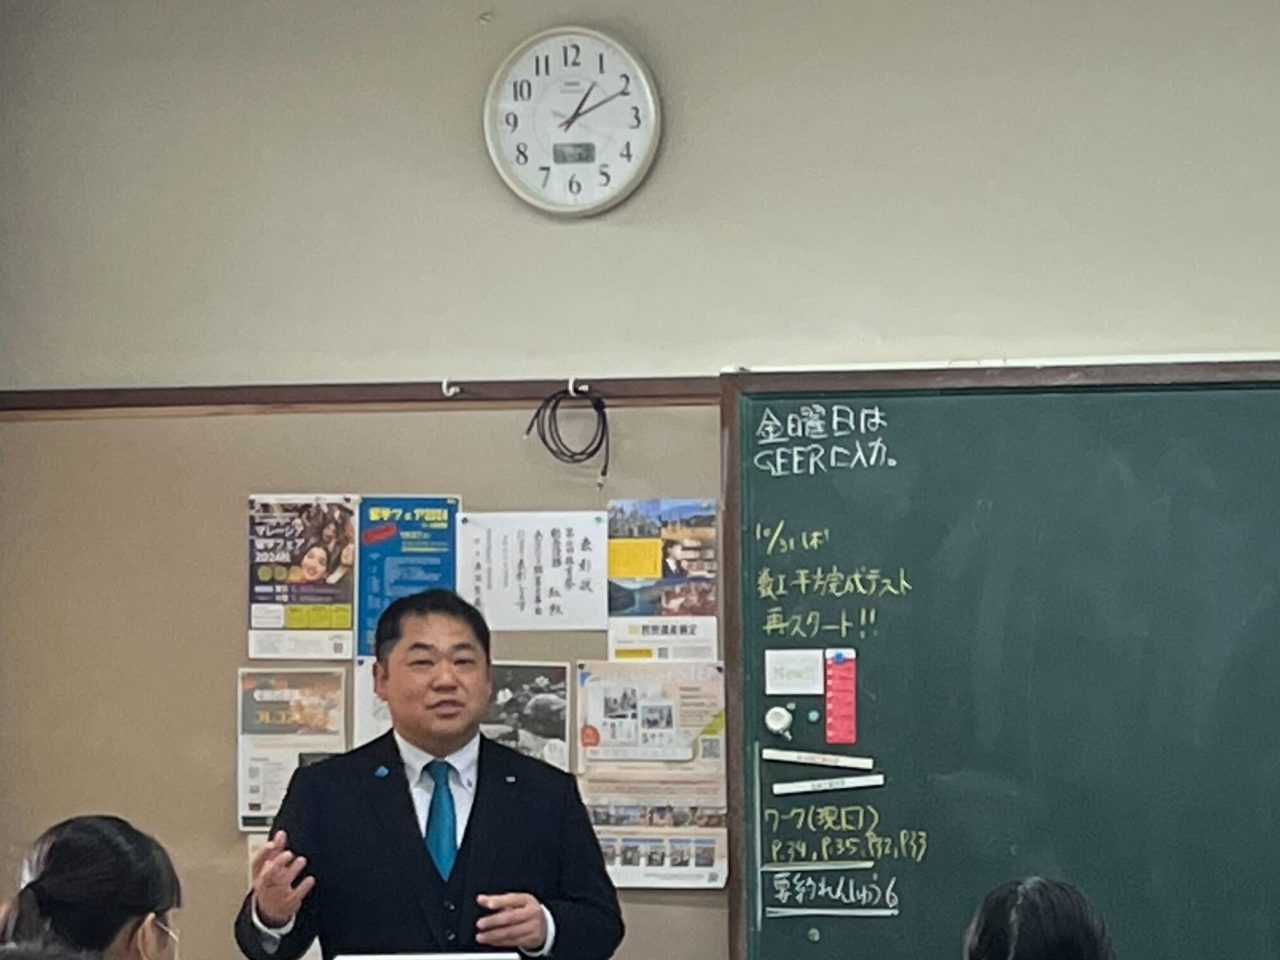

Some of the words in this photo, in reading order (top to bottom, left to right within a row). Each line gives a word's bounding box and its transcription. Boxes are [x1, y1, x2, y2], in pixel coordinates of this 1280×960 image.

[535, 55, 550, 76] 11
[563, 44, 581, 67] 12
[598, 53, 605, 74] 1
[512, 79, 532, 102] 10
[619, 74, 631, 96] 2
[505, 113, 519, 133] 9
[630, 106, 641, 129] 3
[516, 143, 529, 165] 8
[619, 141, 633, 163] 4
[538, 167, 552, 188] 7
[568, 174, 582, 195] 6
[598, 164, 611, 187] 5
[755, 404, 888, 445] 金曜日は
